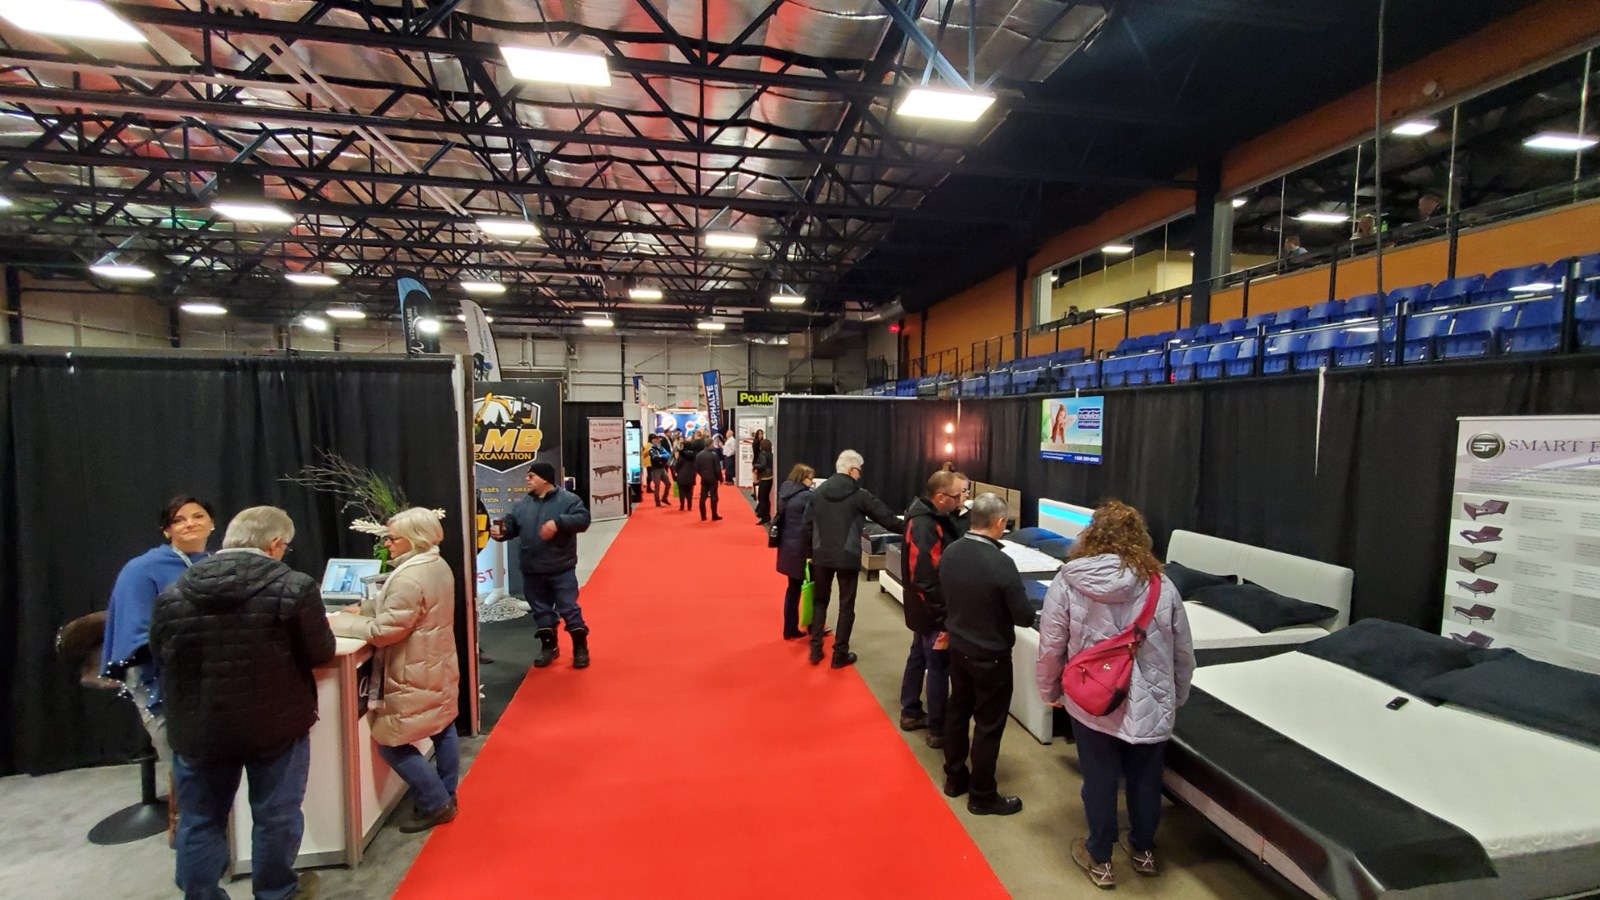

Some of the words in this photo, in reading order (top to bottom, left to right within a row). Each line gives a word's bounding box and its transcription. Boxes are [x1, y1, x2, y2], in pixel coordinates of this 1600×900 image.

[740, 392, 774, 403] Poulio
[706, 384, 719, 431] ASPHALTE
[474, 428, 543, 453] MB
[1508, 439, 1583, 453] SMART
[1590, 440, 1600, 453] F
